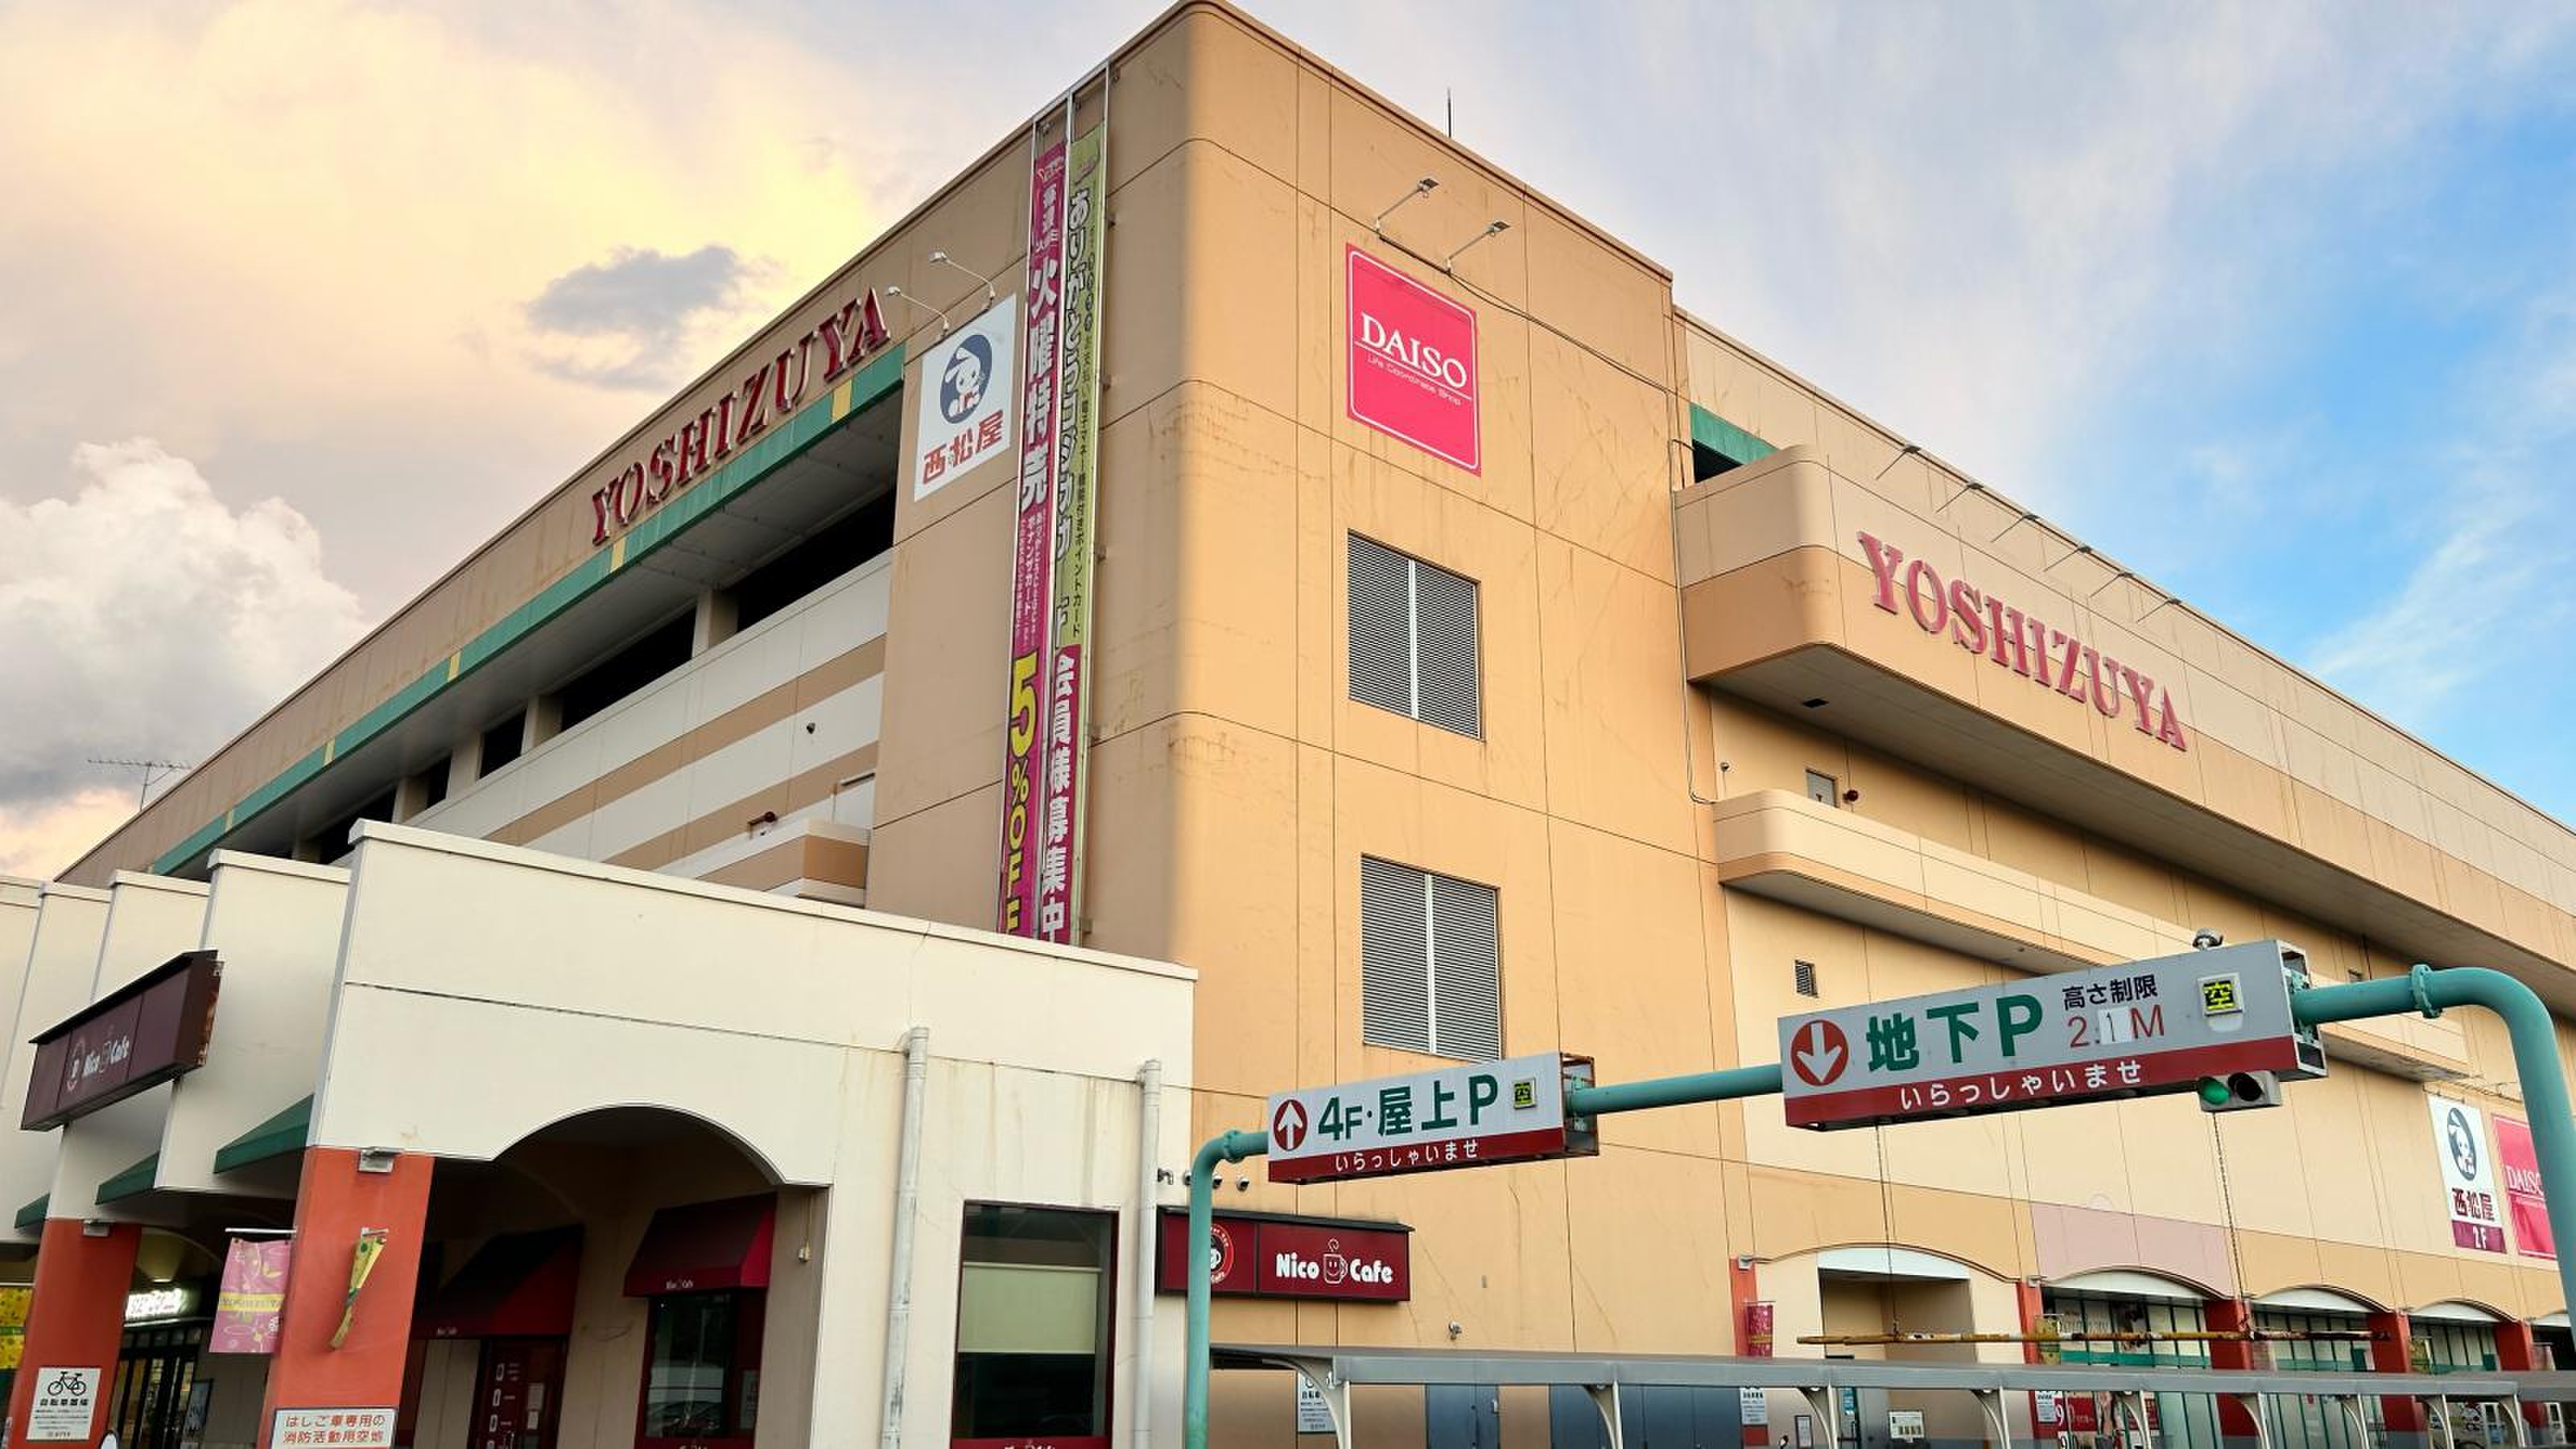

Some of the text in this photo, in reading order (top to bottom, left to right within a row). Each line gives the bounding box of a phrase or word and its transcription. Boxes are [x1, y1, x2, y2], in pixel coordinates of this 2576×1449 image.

[1361, 311, 1468, 388] DAISO
[592, 287, 893, 547] YOSHIZUYA
[923, 409, 1005, 485] 西松屋
[1857, 530, 2188, 752] YOSHIZUYA
[1006, 650, 1038, 933] 5%OFF
[2062, 975, 2158, 1010] 高さ制限
[1866, 996, 2044, 1073] 地下P
[1901, 1060, 2142, 1110] いらっしゃいませ
[1335, 1141, 1480, 1173] いらっしゃいませ
[2451, 1187, 2495, 1222] 西松屋
[1276, 1253, 1393, 1285] Nico Cafe
